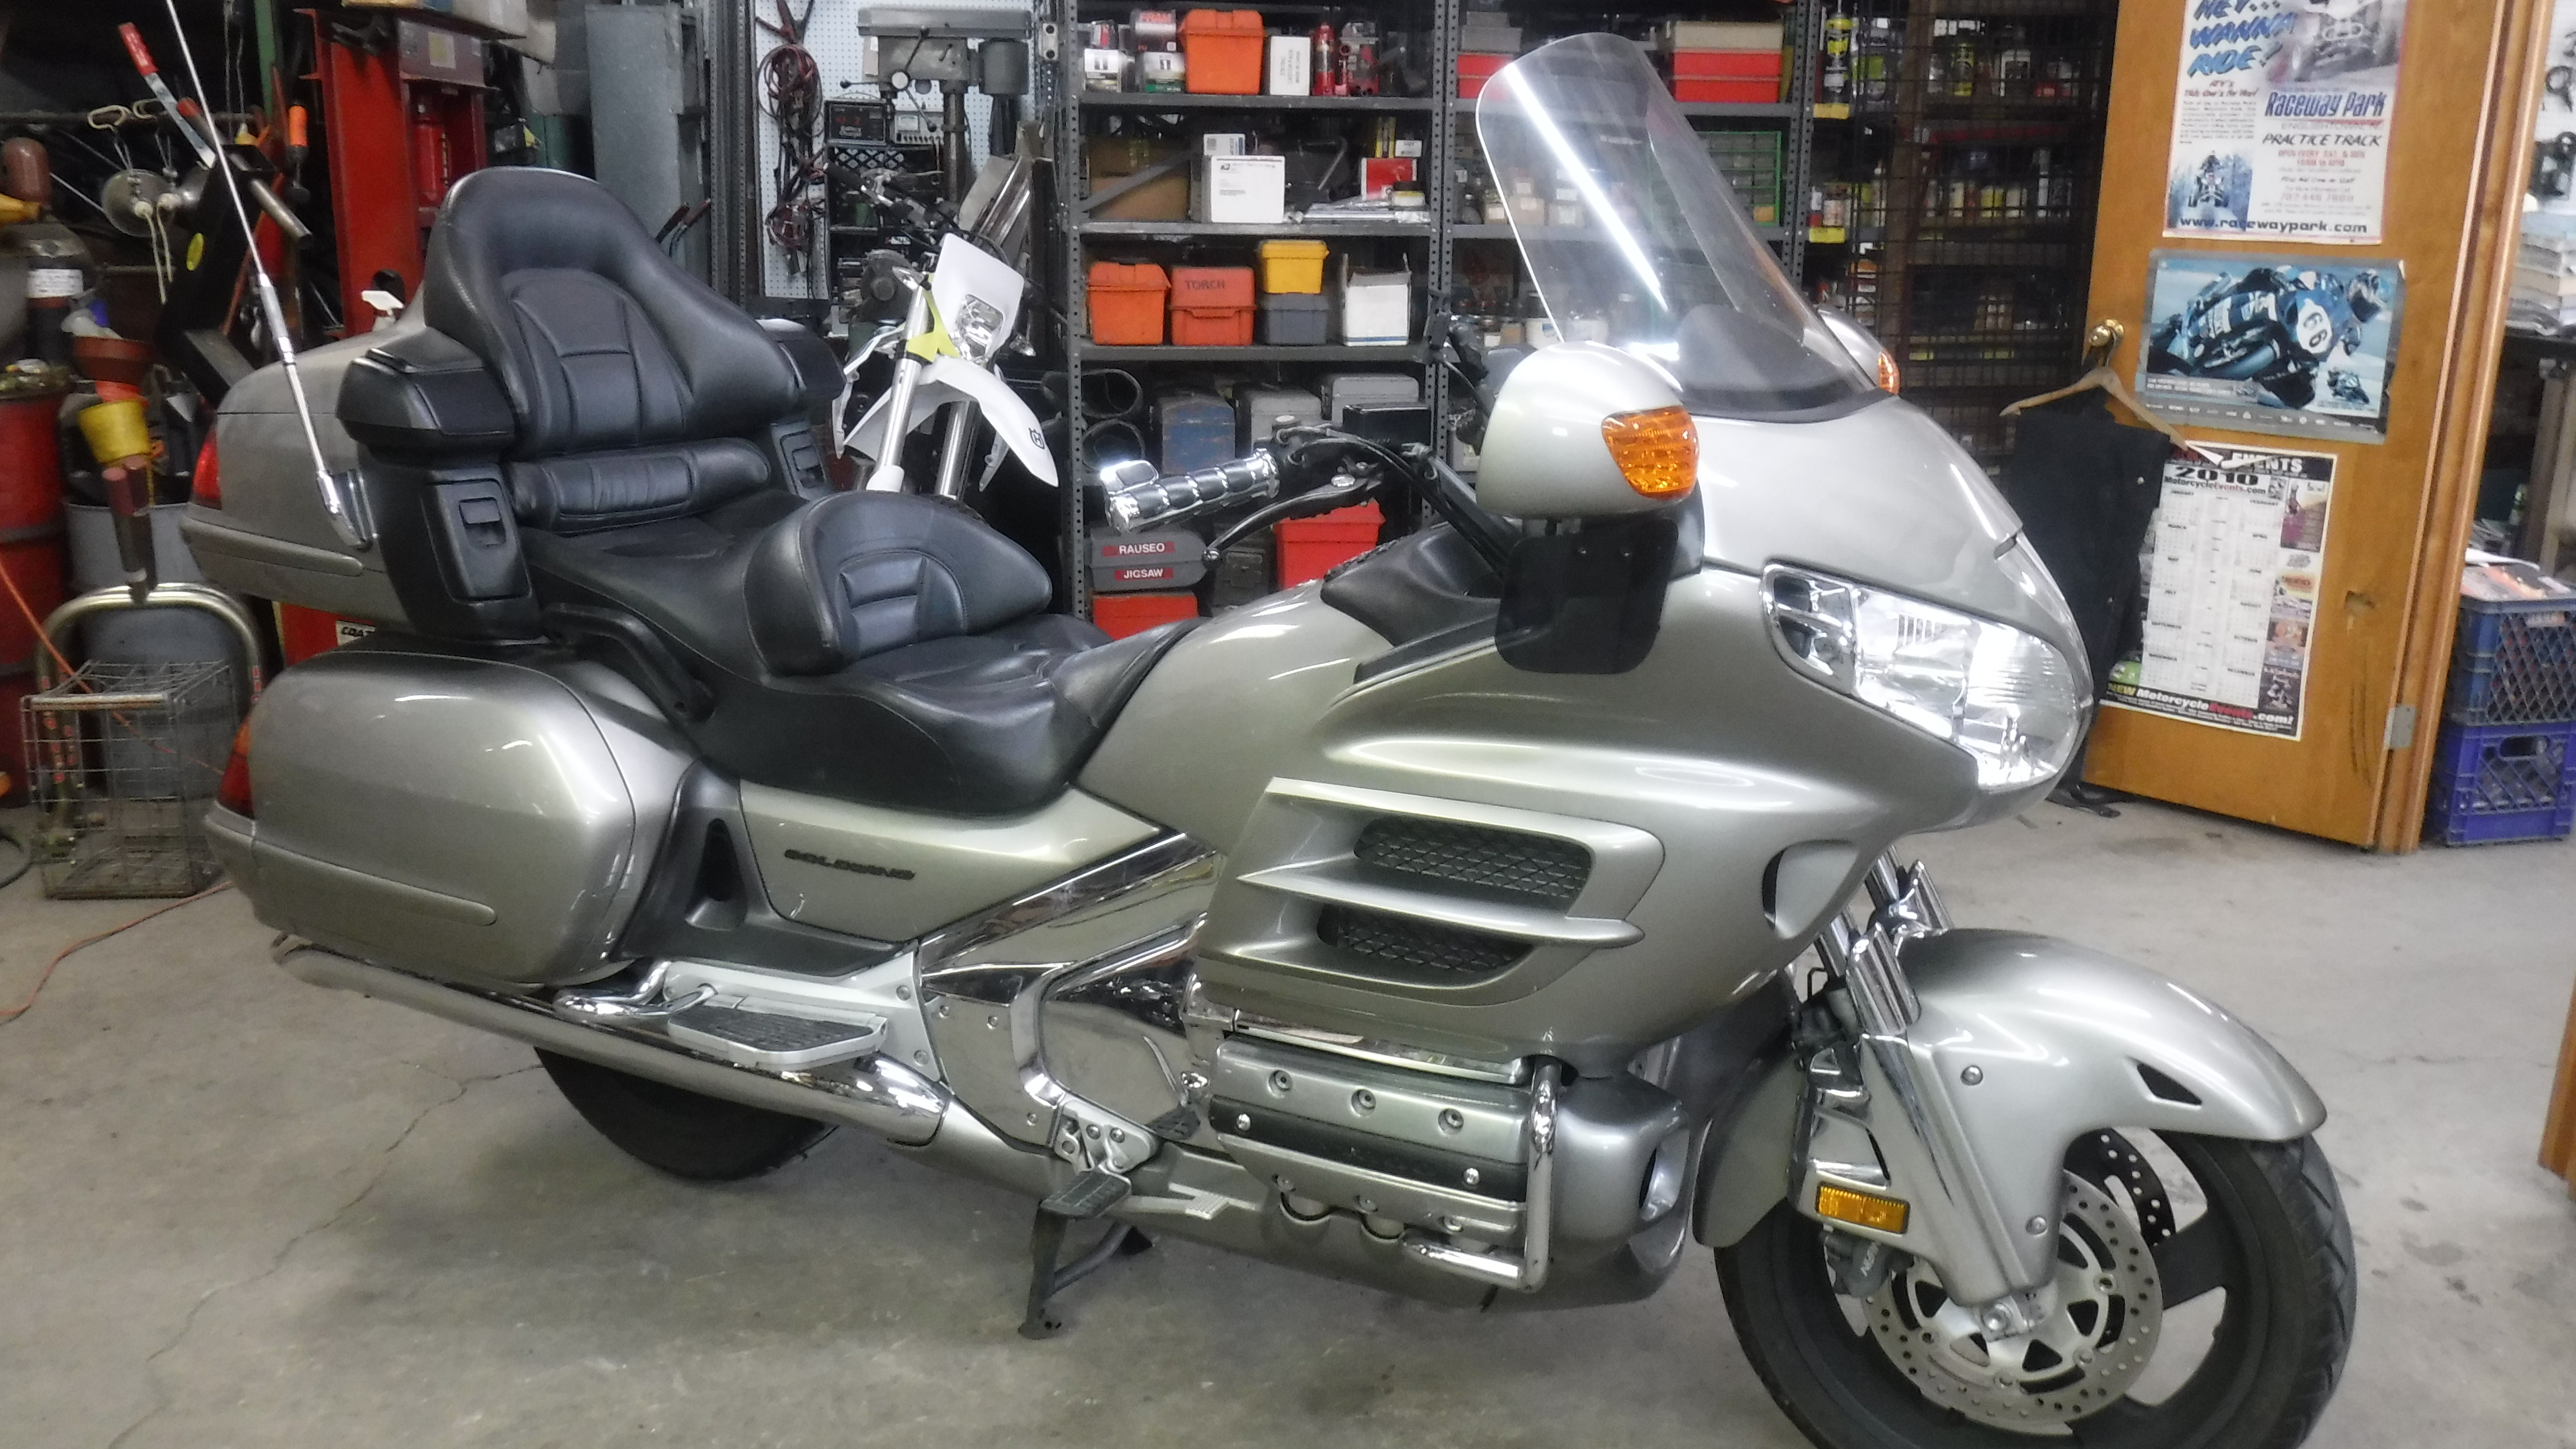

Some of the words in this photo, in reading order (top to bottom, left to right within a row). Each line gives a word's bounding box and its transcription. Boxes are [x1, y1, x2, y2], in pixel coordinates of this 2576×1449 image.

[2190, 11, 2299, 49] WANNA
[2265, 91, 2342, 117] Raceway
[2342, 91, 2387, 117] Park
[2263, 133, 2332, 146] PRACTICE
[2334, 134, 2383, 146] TRACK
[2180, 218, 2367, 234] www.racewaypark.com
[1185, 280, 1225, 290] TORCH
[2176, 466, 2259, 485] 2010
[2164, 476, 2266, 495] MotorcycleEvents.com
[1119, 542, 1166, 555] RAUSEO
[1123, 567, 1164, 580] JIGSAW
[2108, 683, 2137, 696] NEW
[2136, 688, 2295, 726] MotorcycleEvents.com!
